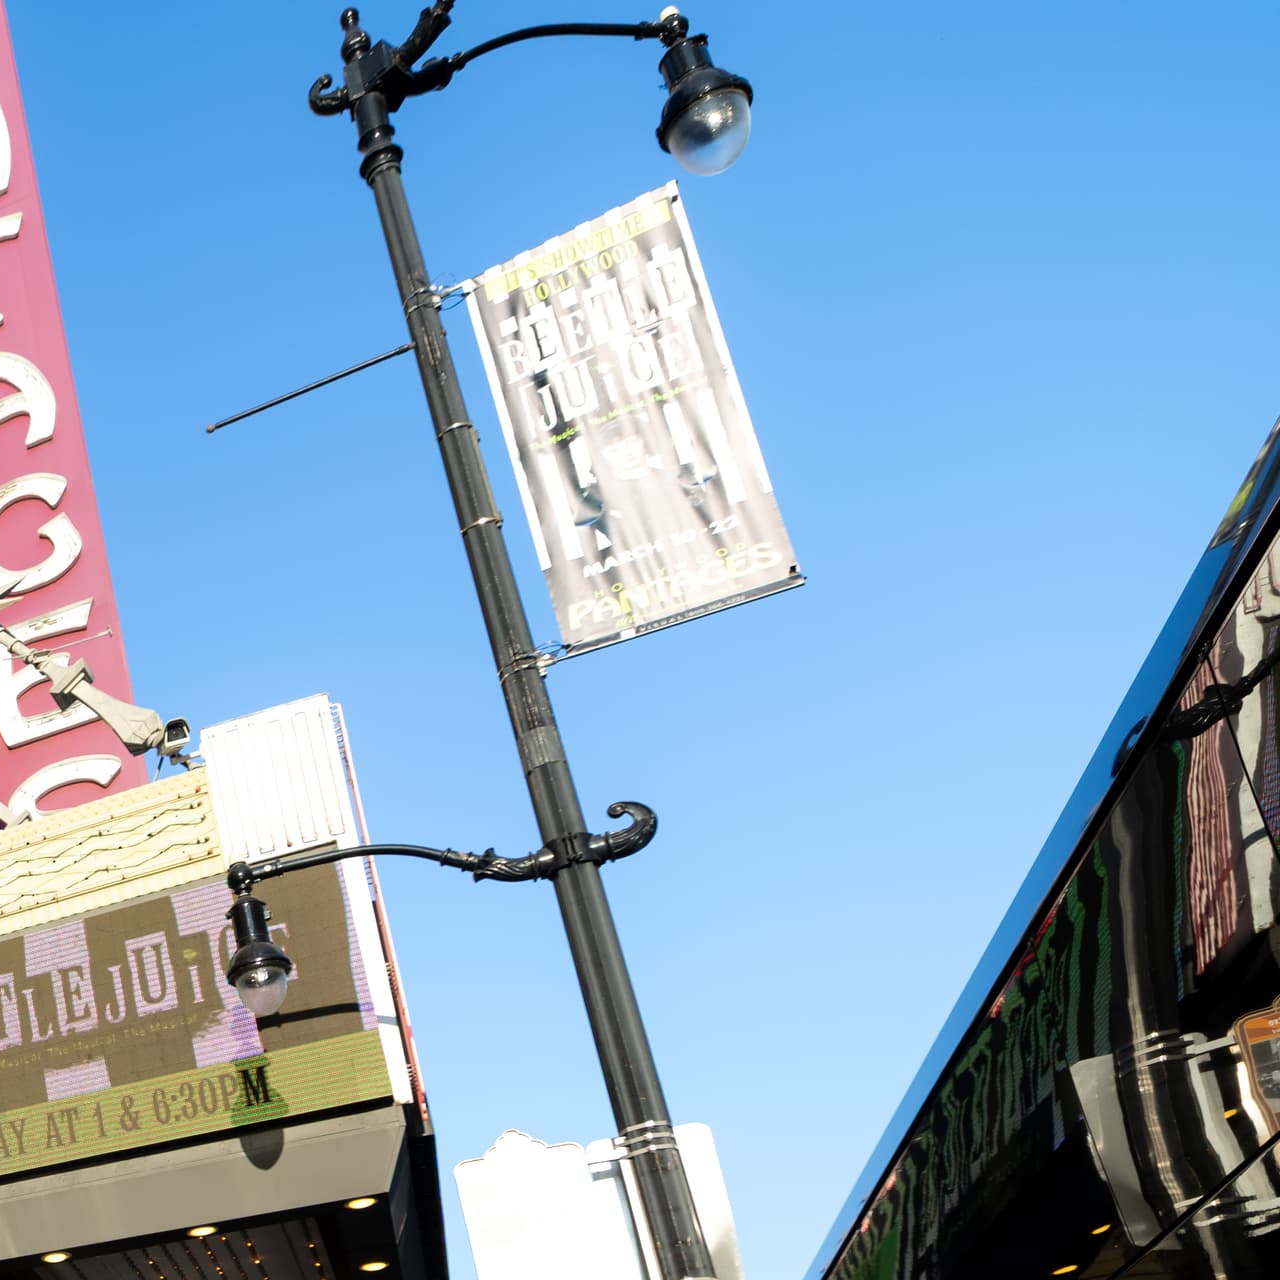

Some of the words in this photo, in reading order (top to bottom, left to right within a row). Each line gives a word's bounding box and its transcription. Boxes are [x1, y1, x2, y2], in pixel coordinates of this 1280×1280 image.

[523, 240, 639, 306] HOLLYWOOD
[498, 258, 690, 385] BEETLE
[567, 541, 783, 632] PANTAGES
[583, 540, 664, 578] MARCH
[44, 1108, 83, 1150] AT
[93, 1106, 108, 1138] 1
[118, 1095, 140, 1130] &
[152, 1065, 273, 1126] 6:30PM
